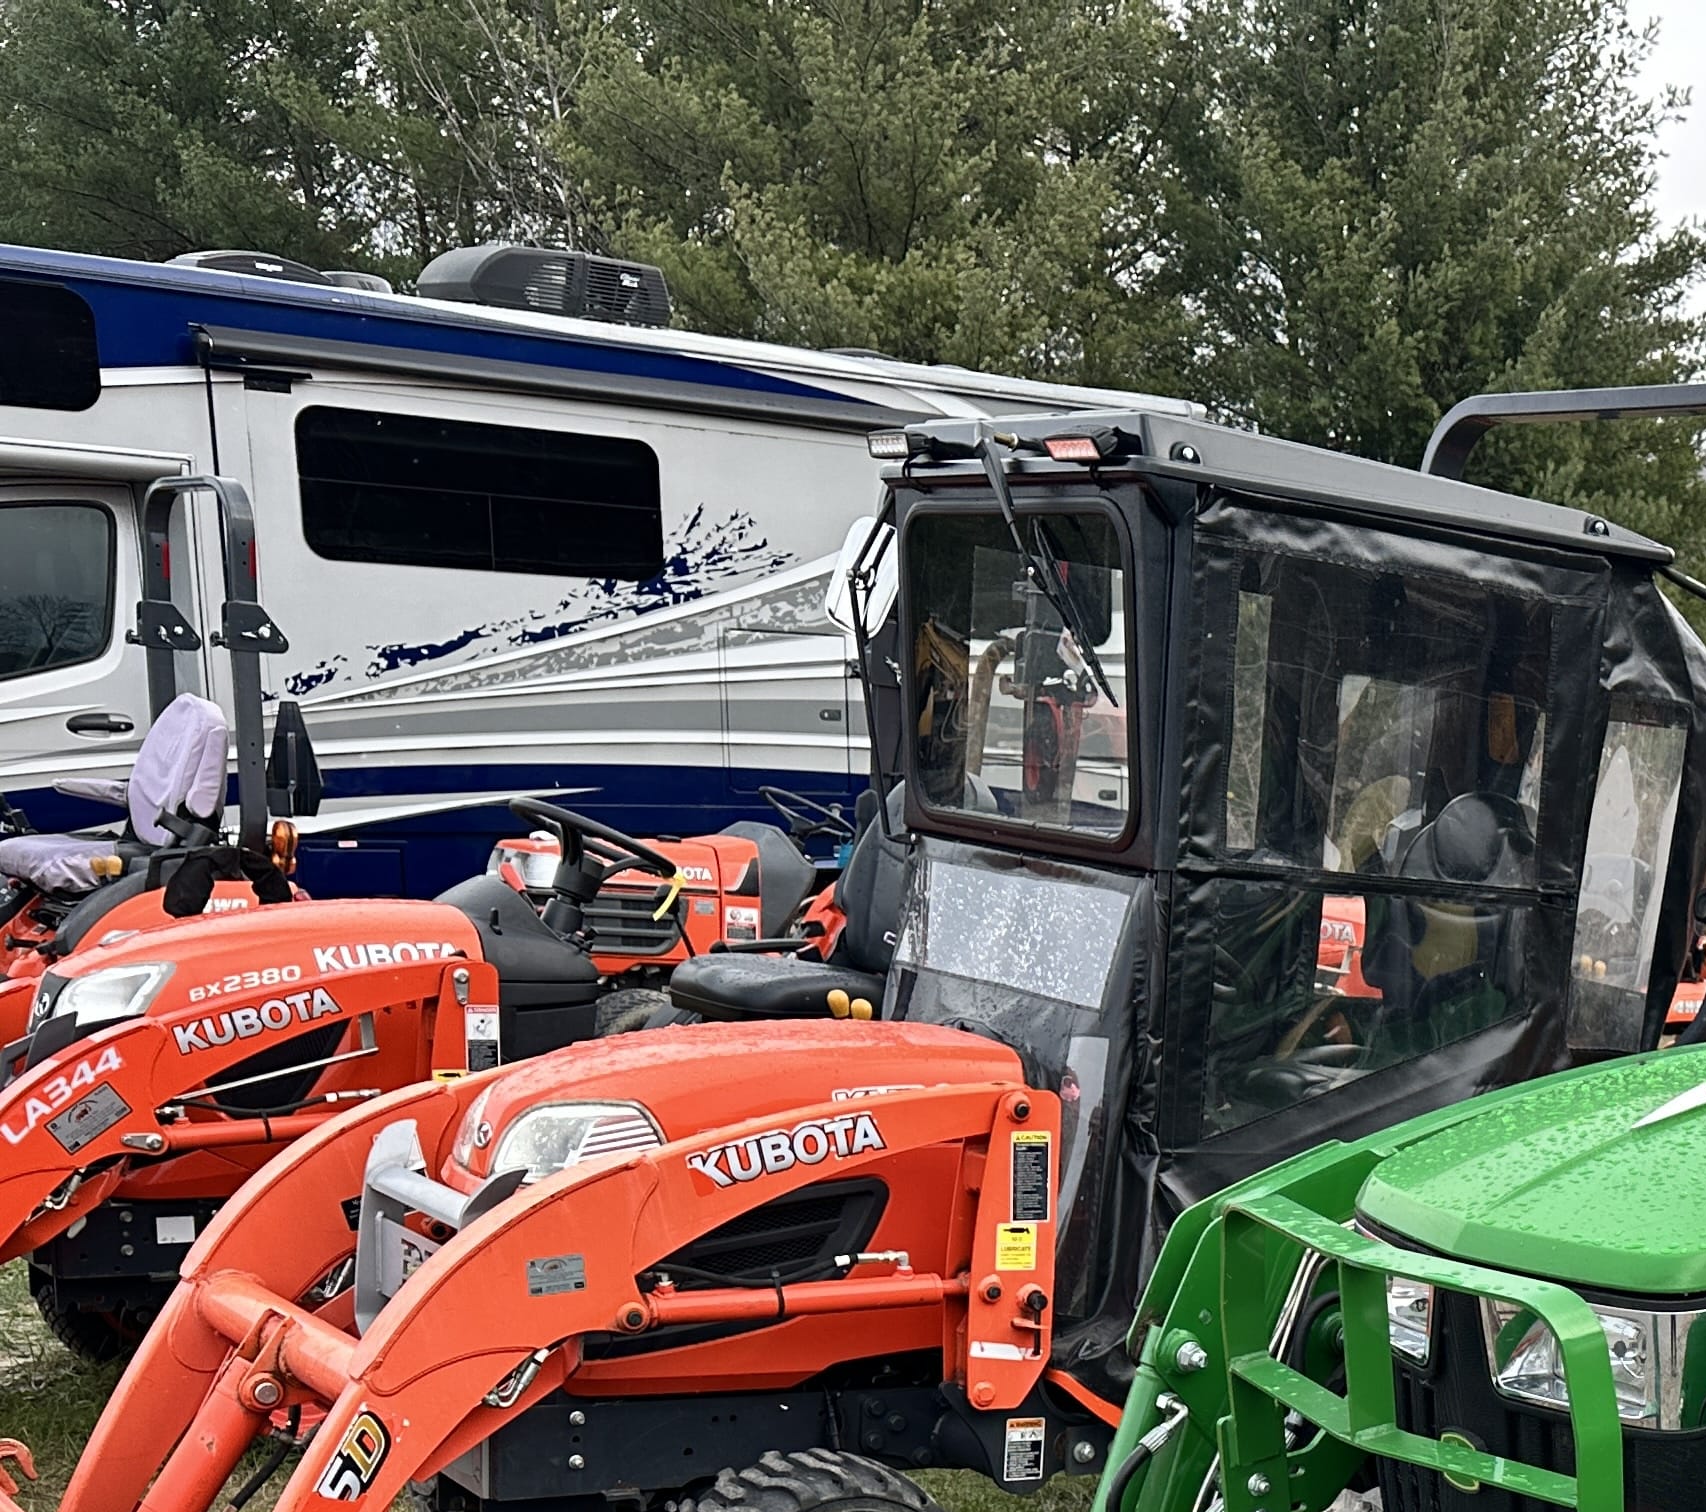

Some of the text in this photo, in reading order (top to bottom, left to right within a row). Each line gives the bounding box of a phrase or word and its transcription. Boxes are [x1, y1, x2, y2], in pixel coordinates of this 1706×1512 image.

[1320, 921, 1355, 945] OTA
[189, 965, 302, 1003] BX2380
[172, 986, 343, 1055] KUBOTA
[0, 1046, 124, 1145] LA344
[688, 1113, 888, 1188] KUBOTA
